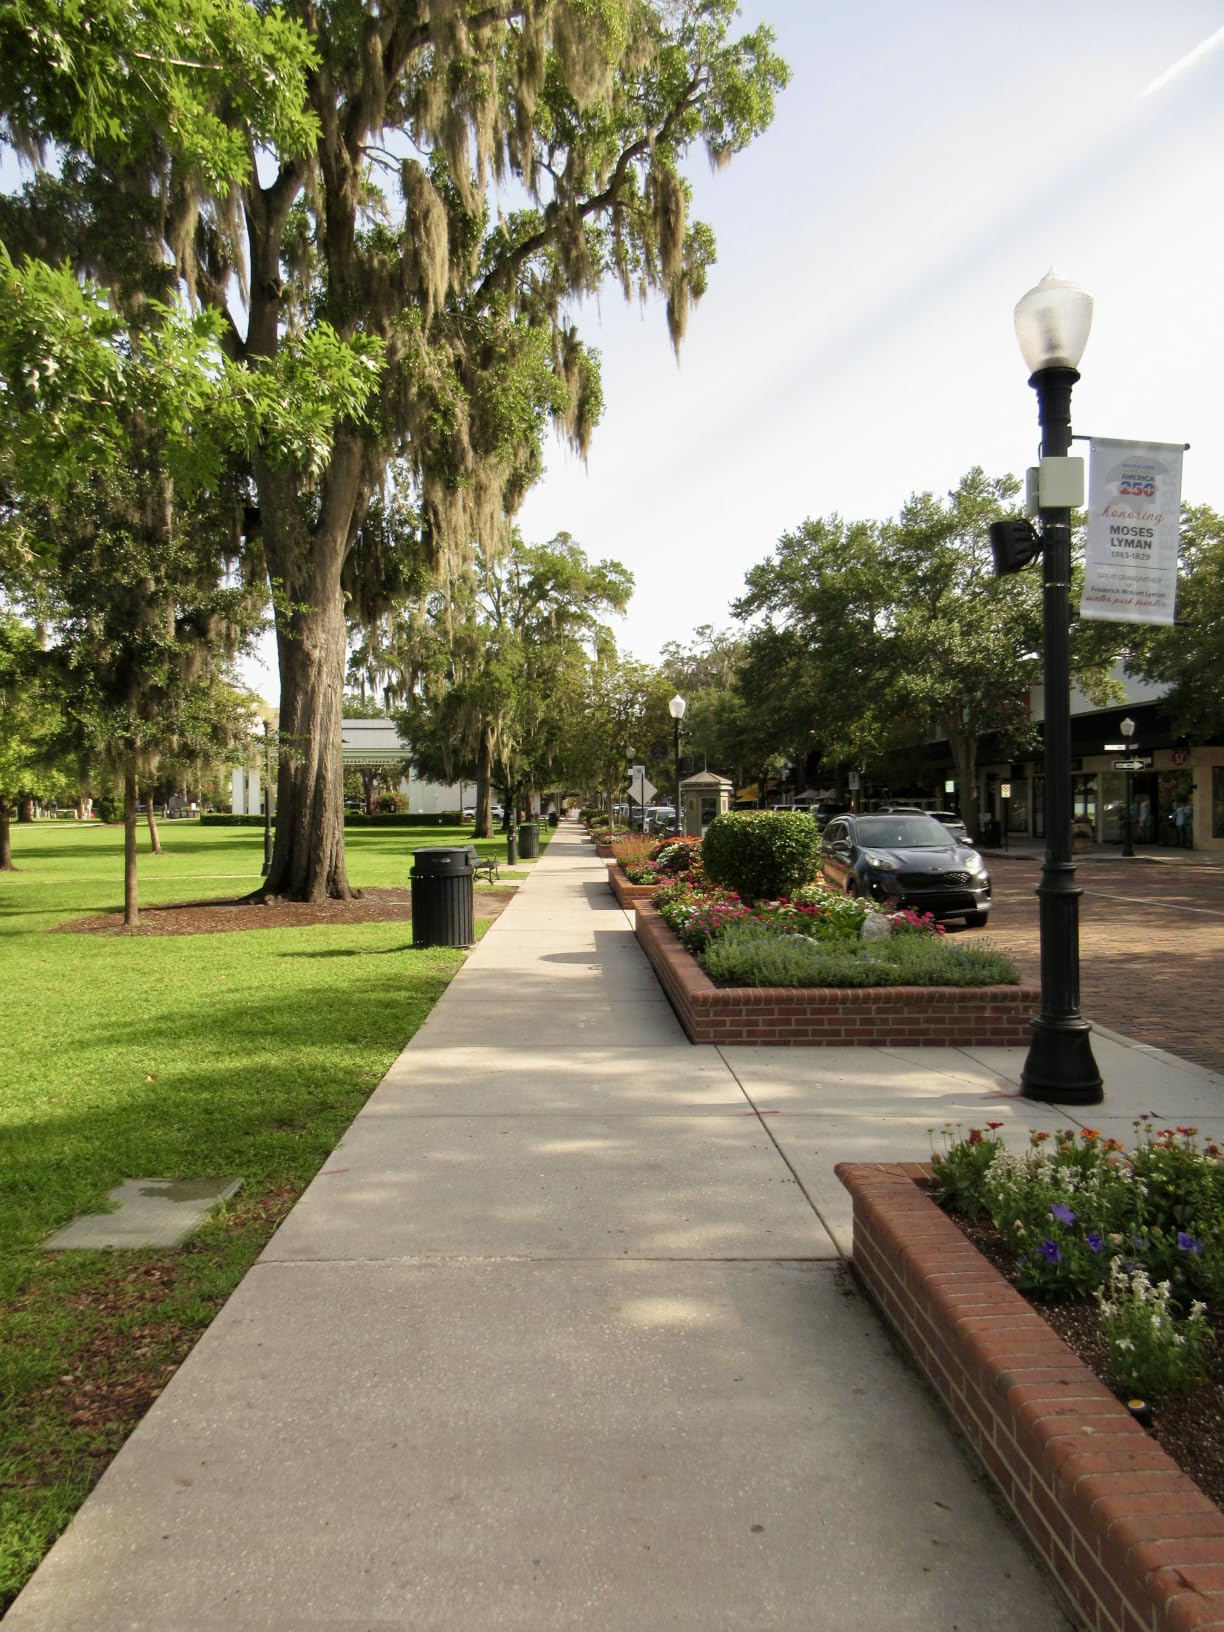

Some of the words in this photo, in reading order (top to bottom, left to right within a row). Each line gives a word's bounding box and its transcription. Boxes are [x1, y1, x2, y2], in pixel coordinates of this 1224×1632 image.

[1121, 473, 1155, 482] AMERICA
[1120, 481, 1155, 497] 250
[1102, 506, 1164, 526] honoring
[1110, 525, 1154, 538] MOSES
[1111, 537, 1152, 549] LYMAN
[1111, 551, 1151, 561] 1743-1829
